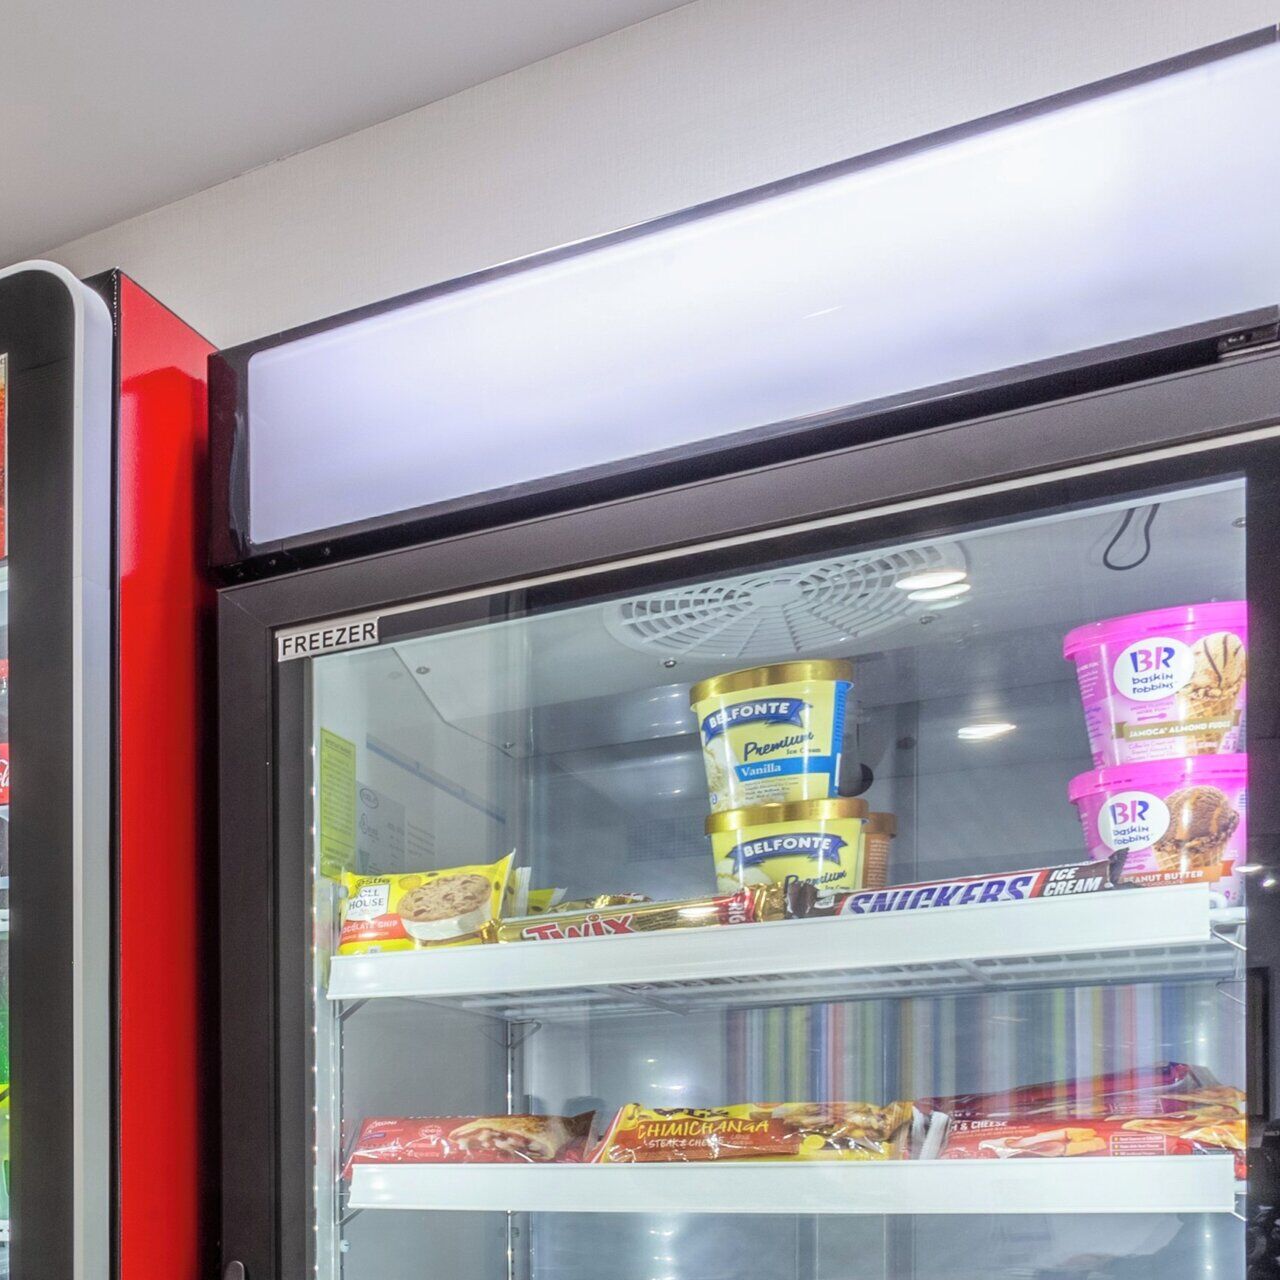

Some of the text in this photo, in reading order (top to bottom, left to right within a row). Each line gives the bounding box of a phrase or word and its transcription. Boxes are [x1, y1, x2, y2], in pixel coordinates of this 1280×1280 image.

[281, 622, 376, 656] FREEZER
[1130, 647, 1175, 673] BR
[1132, 673, 1173, 685] baskin
[1132, 682, 1174, 694] robbins
[709, 702, 790, 728] BELFONTE
[1169, 723, 1208, 735] ALMOND
[744, 732, 815, 761] Premium
[741, 763, 781, 776] Vanilla
[1110, 800, 1150, 826] BR
[1113, 826, 1149, 837] baskin
[1113, 834, 1150, 845] robbins
[743, 837, 831, 857] BELFONTE
[1123, 870, 1204, 884] PEANUT BUTTER
[850, 867, 1103, 915] SNICKERS ICE CREAM
[349, 897, 385, 908] HOUSE
[638, 1120, 769, 1139] CHIMICHANGA
[971, 1120, 1008, 1130] CHEESE
